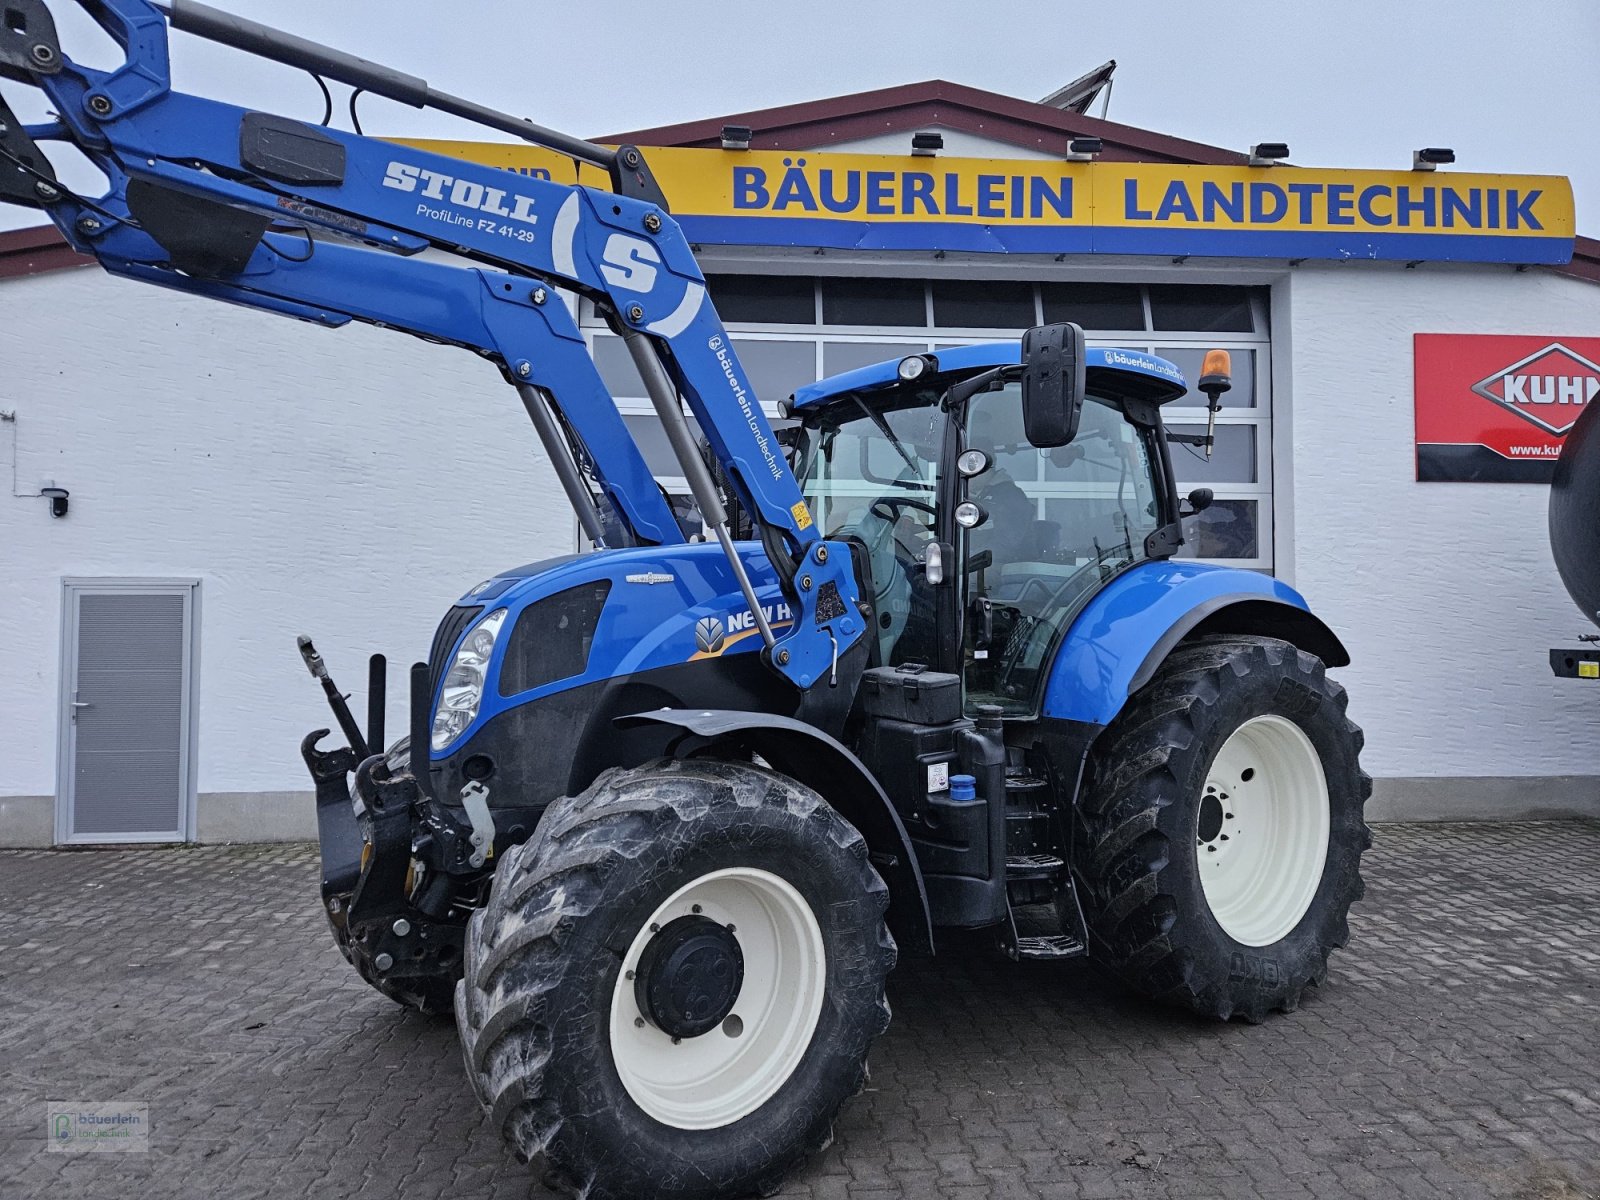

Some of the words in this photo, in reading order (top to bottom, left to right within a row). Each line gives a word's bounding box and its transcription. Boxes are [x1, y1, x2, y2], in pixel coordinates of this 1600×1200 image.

[382, 161, 538, 225] STOLL
[416, 203, 474, 228] ProfiLine
[477, 219, 496, 233] FZ
[498, 225, 535, 243] 41-29
[733, 157, 1073, 219] BÄUERLEIN
[1124, 178, 1544, 231] LANDTECHNIK
[600, 233, 660, 293] S
